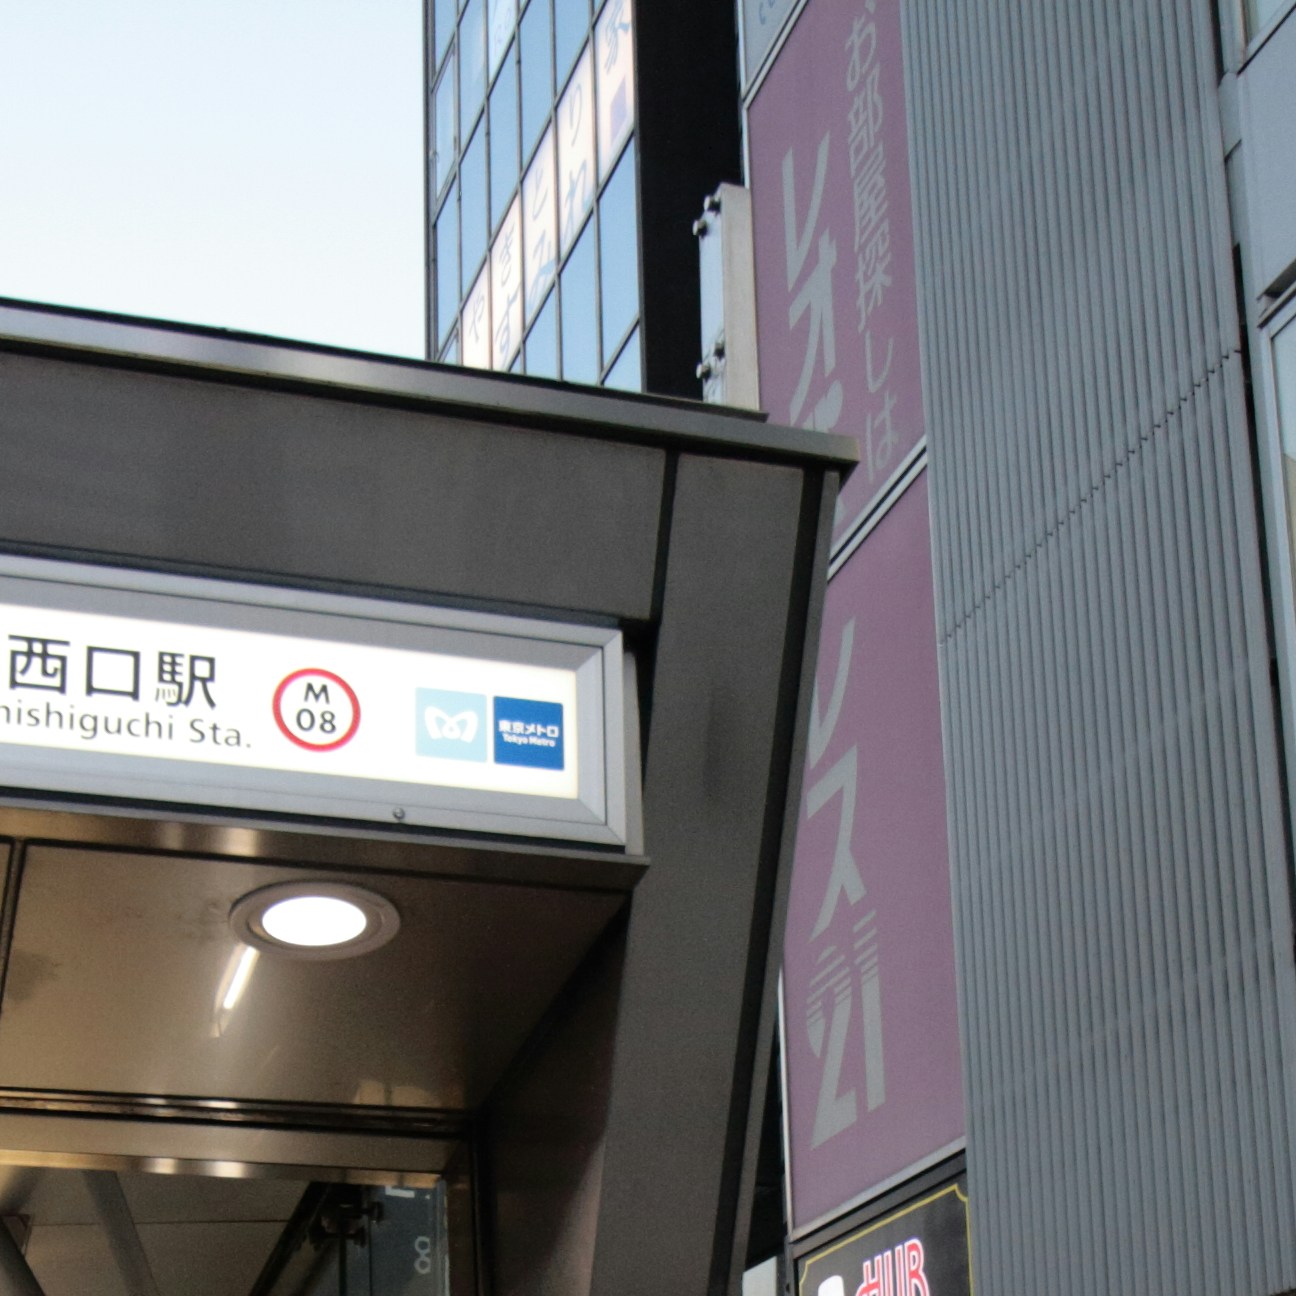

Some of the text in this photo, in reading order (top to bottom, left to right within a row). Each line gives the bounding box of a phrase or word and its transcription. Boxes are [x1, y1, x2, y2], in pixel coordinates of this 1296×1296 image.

[303, 682, 332, 705] M
[188, 714, 253, 749] Sta.
[294, 706, 338, 736] 08
[499, 718, 560, 739] 東京メトロ
[502, 733, 556, 748] Tokyo Metro
